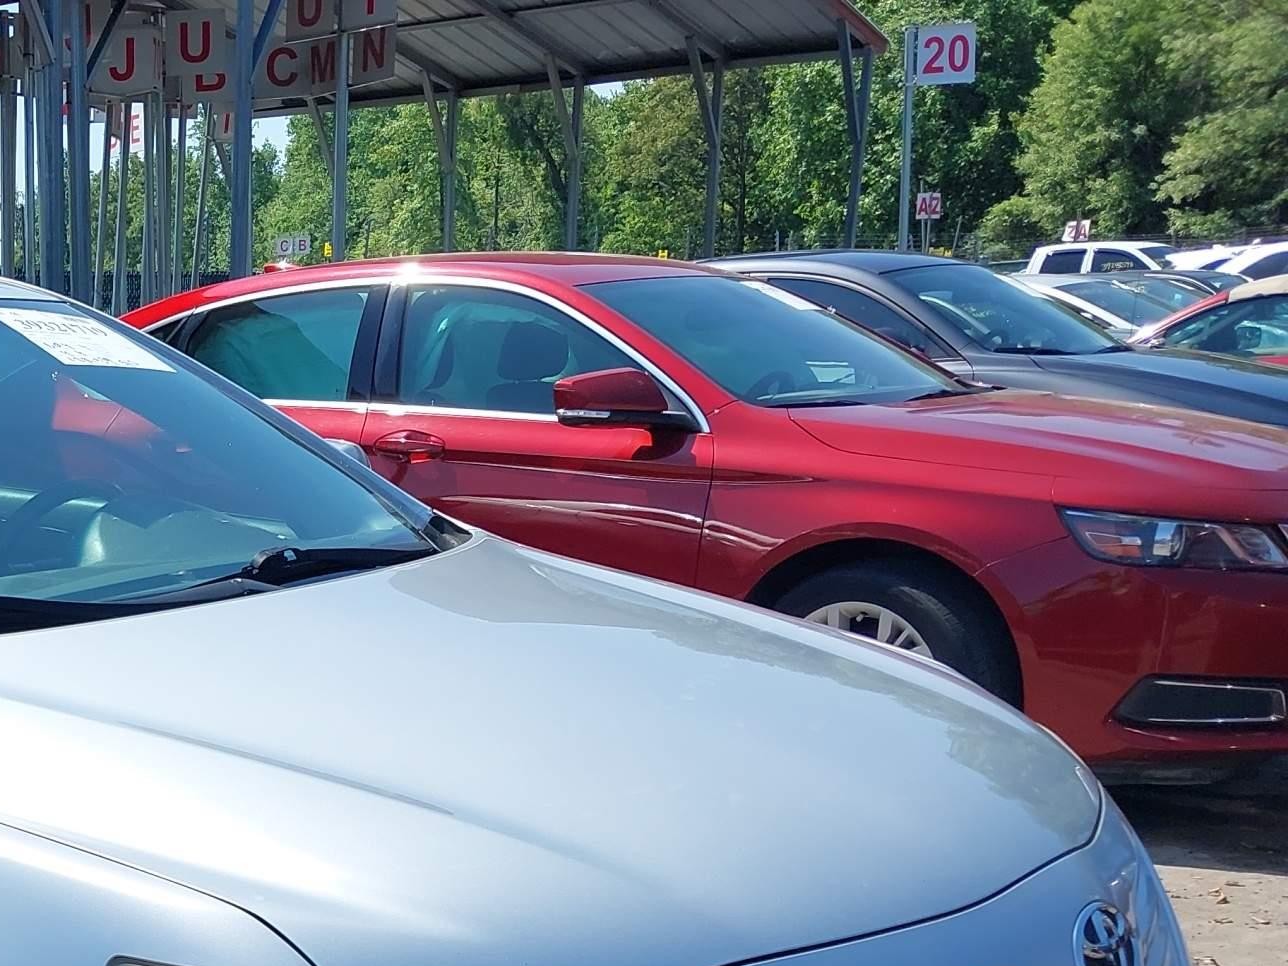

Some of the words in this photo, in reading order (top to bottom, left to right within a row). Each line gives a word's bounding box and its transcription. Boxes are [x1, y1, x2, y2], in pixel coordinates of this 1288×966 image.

[109, 37, 135, 81] J
[179, 21, 211, 63] U
[312, 40, 337, 85] M
[362, 27, 386, 73] N
[922, 34, 970, 75] 20
[266, 47, 298, 87] C
[280, 240, 289, 252] C
[298, 240, 307, 251] B
